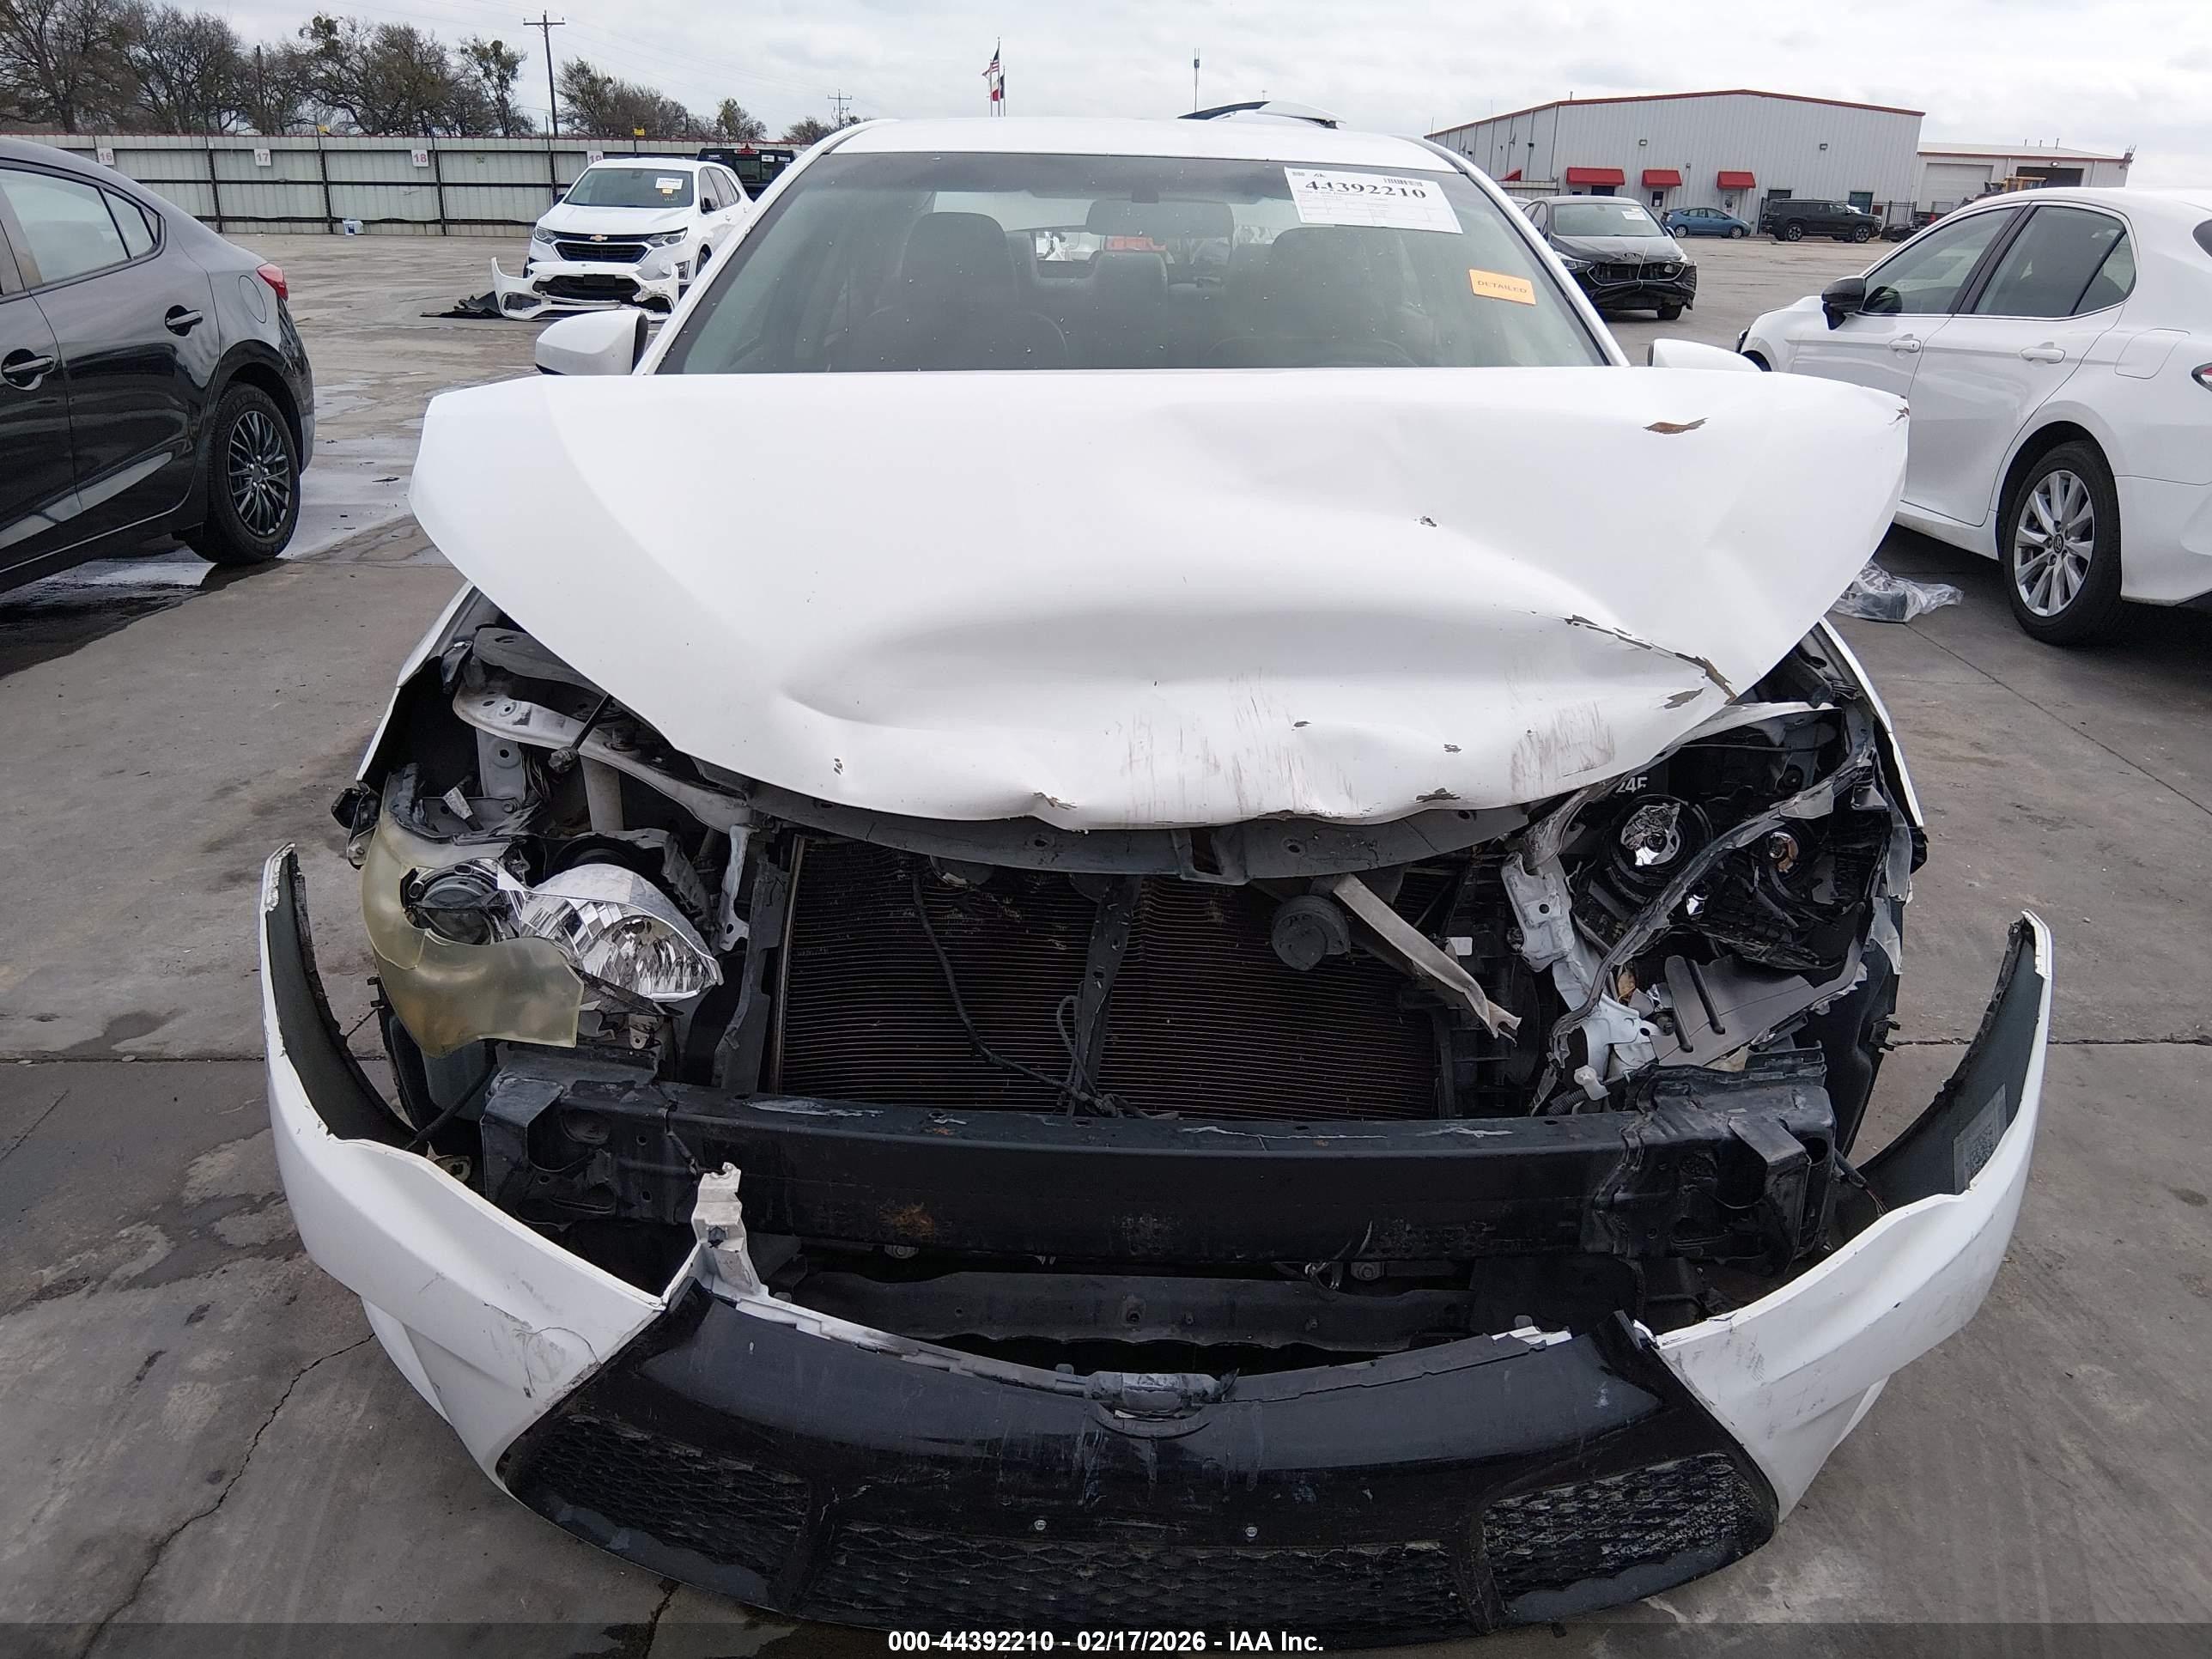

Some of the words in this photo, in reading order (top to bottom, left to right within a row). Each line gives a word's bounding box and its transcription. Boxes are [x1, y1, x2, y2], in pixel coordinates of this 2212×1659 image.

[100, 152, 113, 161] 16
[256, 152, 270, 162] 17
[413, 153, 428, 163] 18
[1305, 179, 1426, 199] 44392210
[1477, 279, 1528, 294] DETAILED
